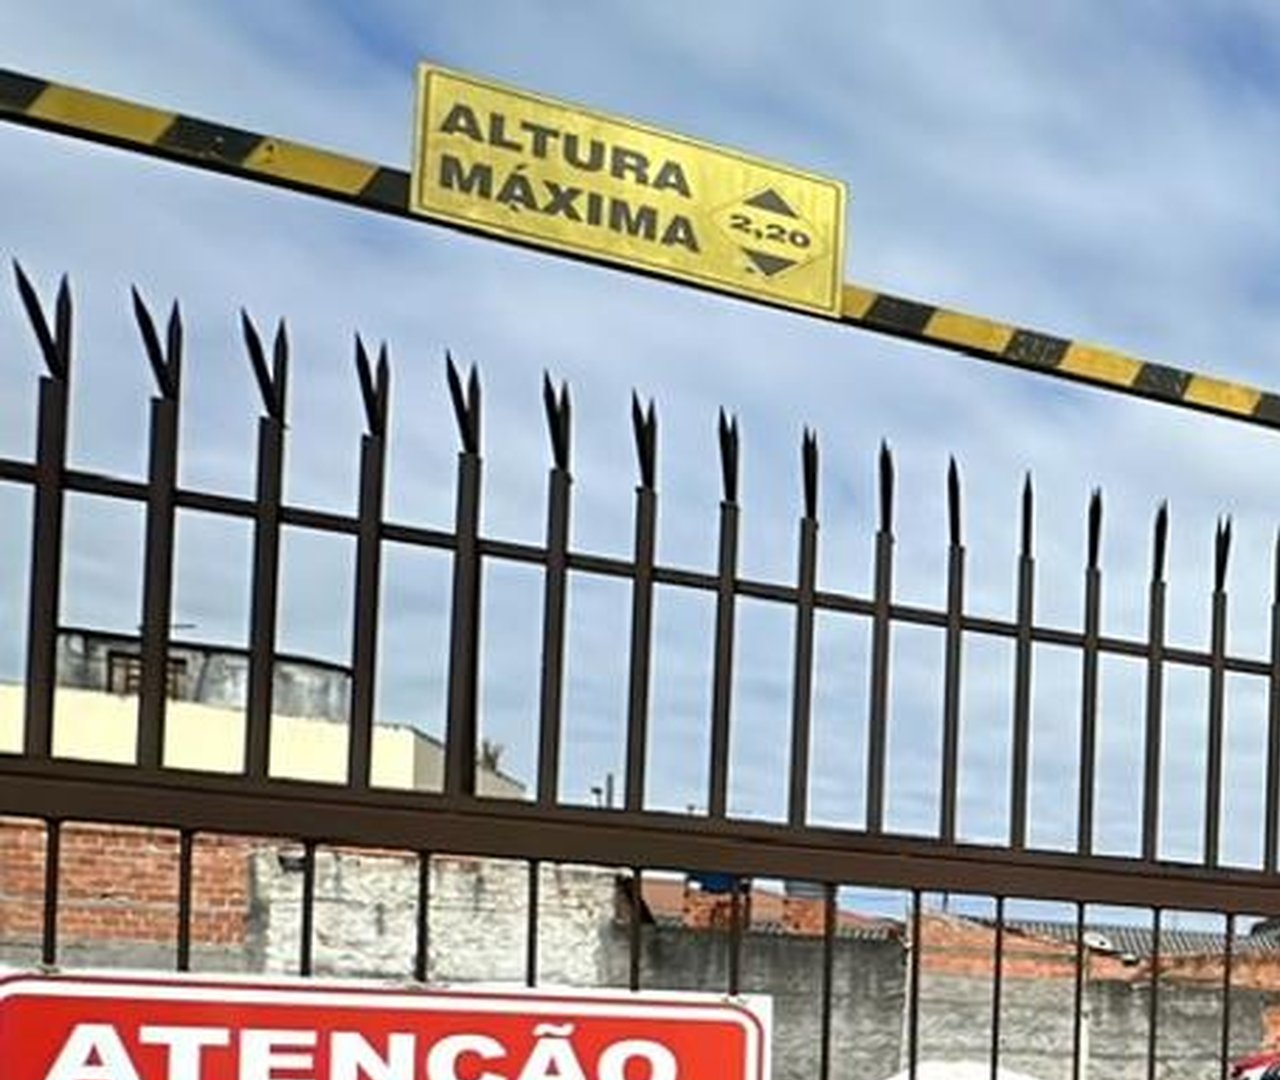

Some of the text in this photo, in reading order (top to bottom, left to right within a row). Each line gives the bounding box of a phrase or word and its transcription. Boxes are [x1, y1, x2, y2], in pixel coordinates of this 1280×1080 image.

[440, 102, 693, 198] ALTURA
[439, 154, 700, 253] MÁXIMA
[730, 212, 811, 248] 2,20
